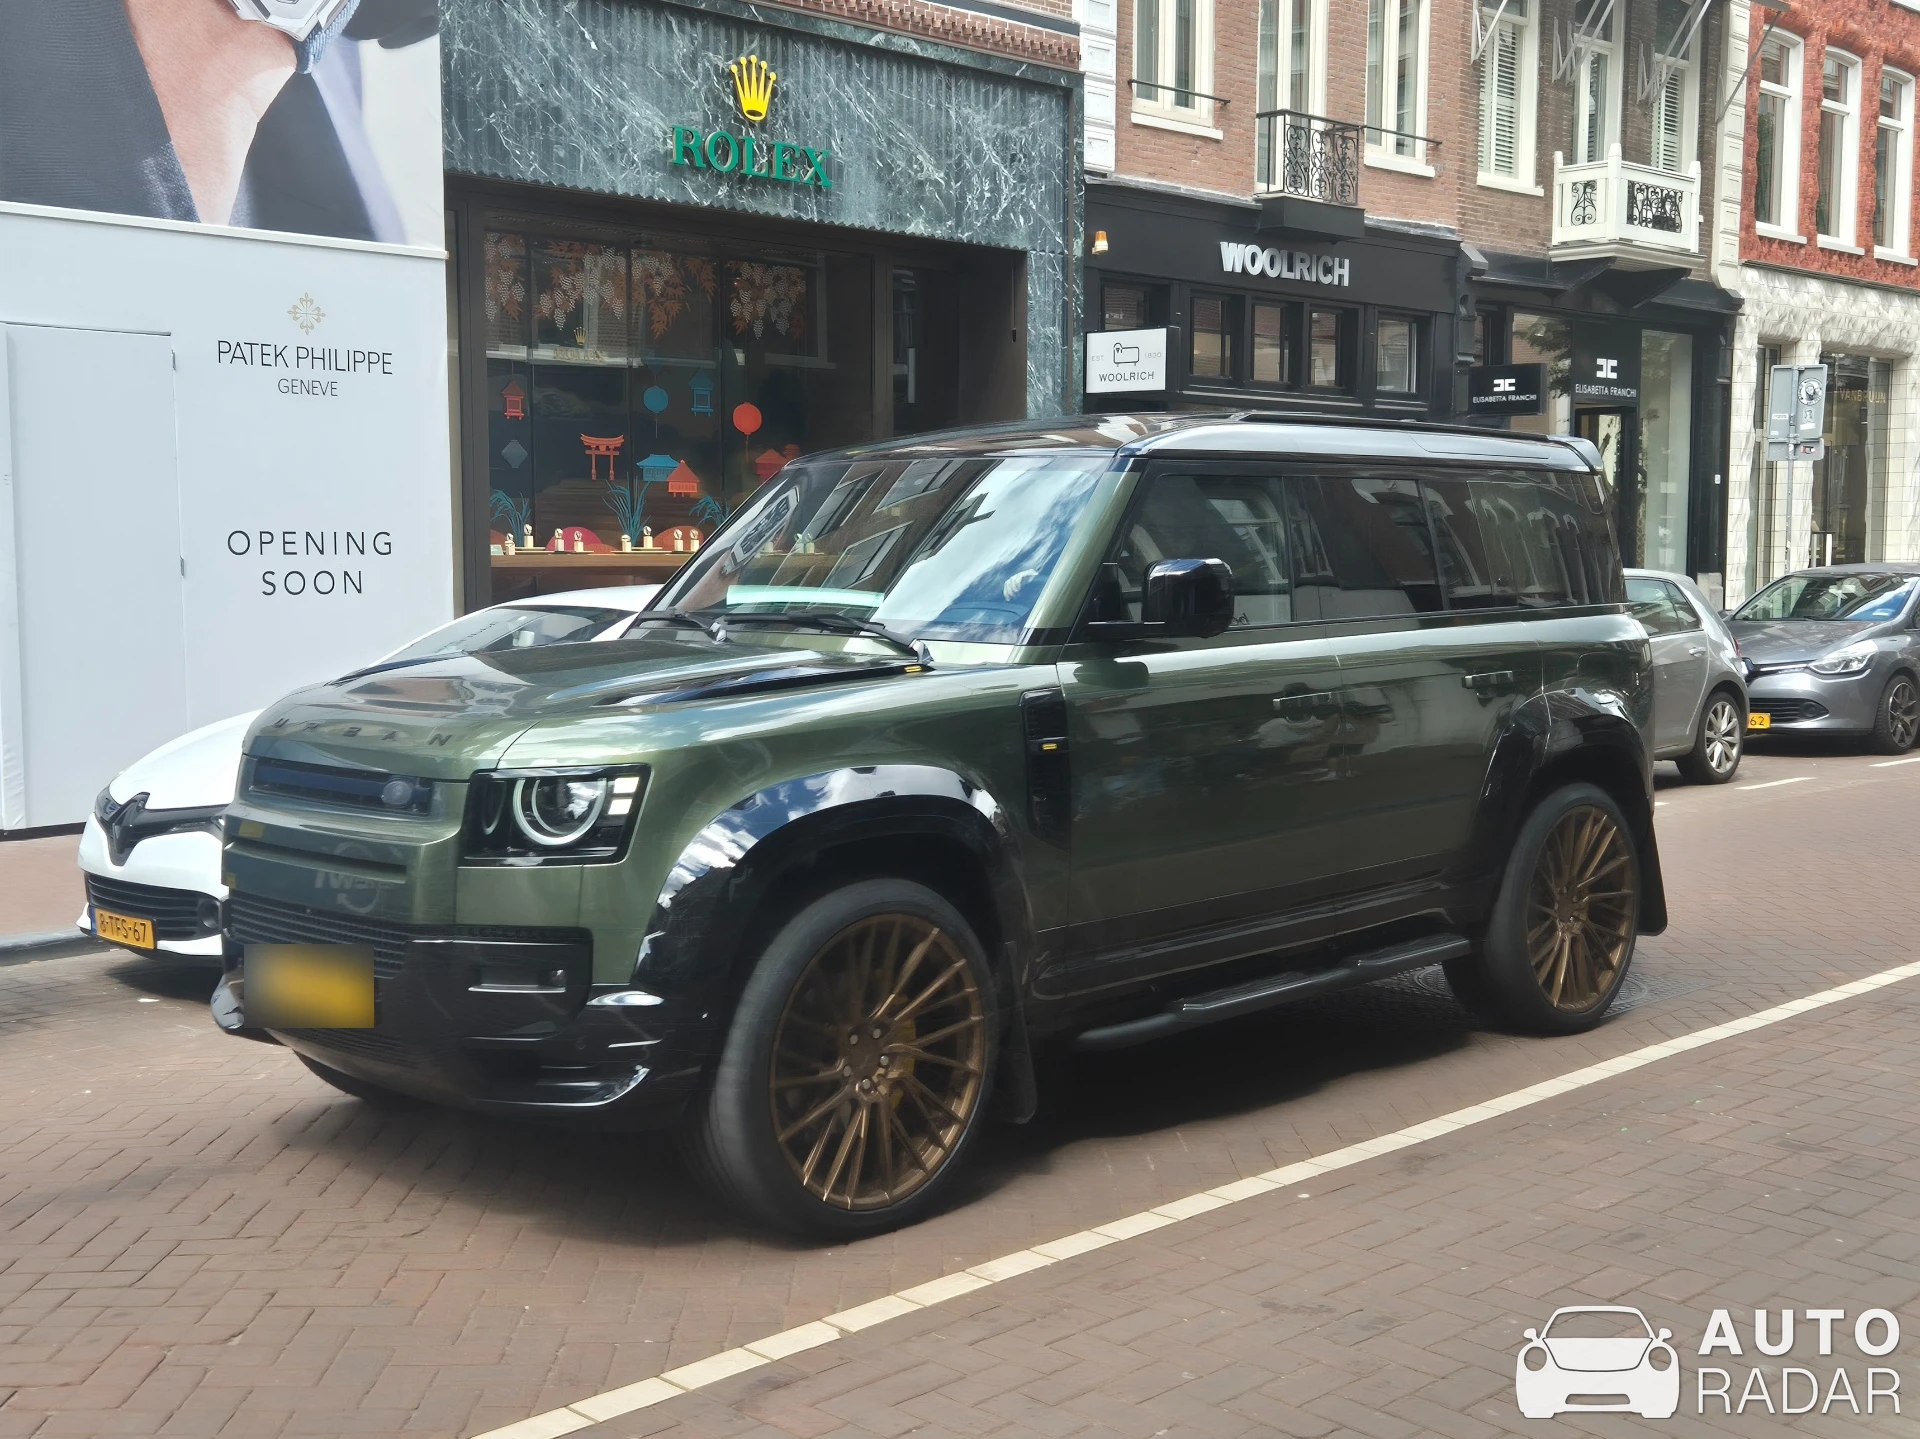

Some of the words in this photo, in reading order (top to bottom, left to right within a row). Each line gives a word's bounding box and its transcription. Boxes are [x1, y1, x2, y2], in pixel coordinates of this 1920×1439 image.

[668, 125, 833, 189] ROLEX
[1219, 241, 1350, 287] WOOLRICH
[217, 340, 289, 369] PATEK
[296, 345, 393, 375] PHILIPPE
[277, 378, 339, 397] GENEVE
[1098, 371, 1155, 382] WOOLRICH
[1472, 396, 1507, 404] ELISABETTA
[1575, 383, 1609, 396] ELISABETTA
[1610, 386, 1637, 398] FRANCHI
[227, 530, 392, 556] OPENING
[261, 570, 363, 596] SOON
[273, 717, 453, 747] URBAN
[1750, 715, 1765, 726] 62
[100, 913, 147, 943] 8-TFS-67
